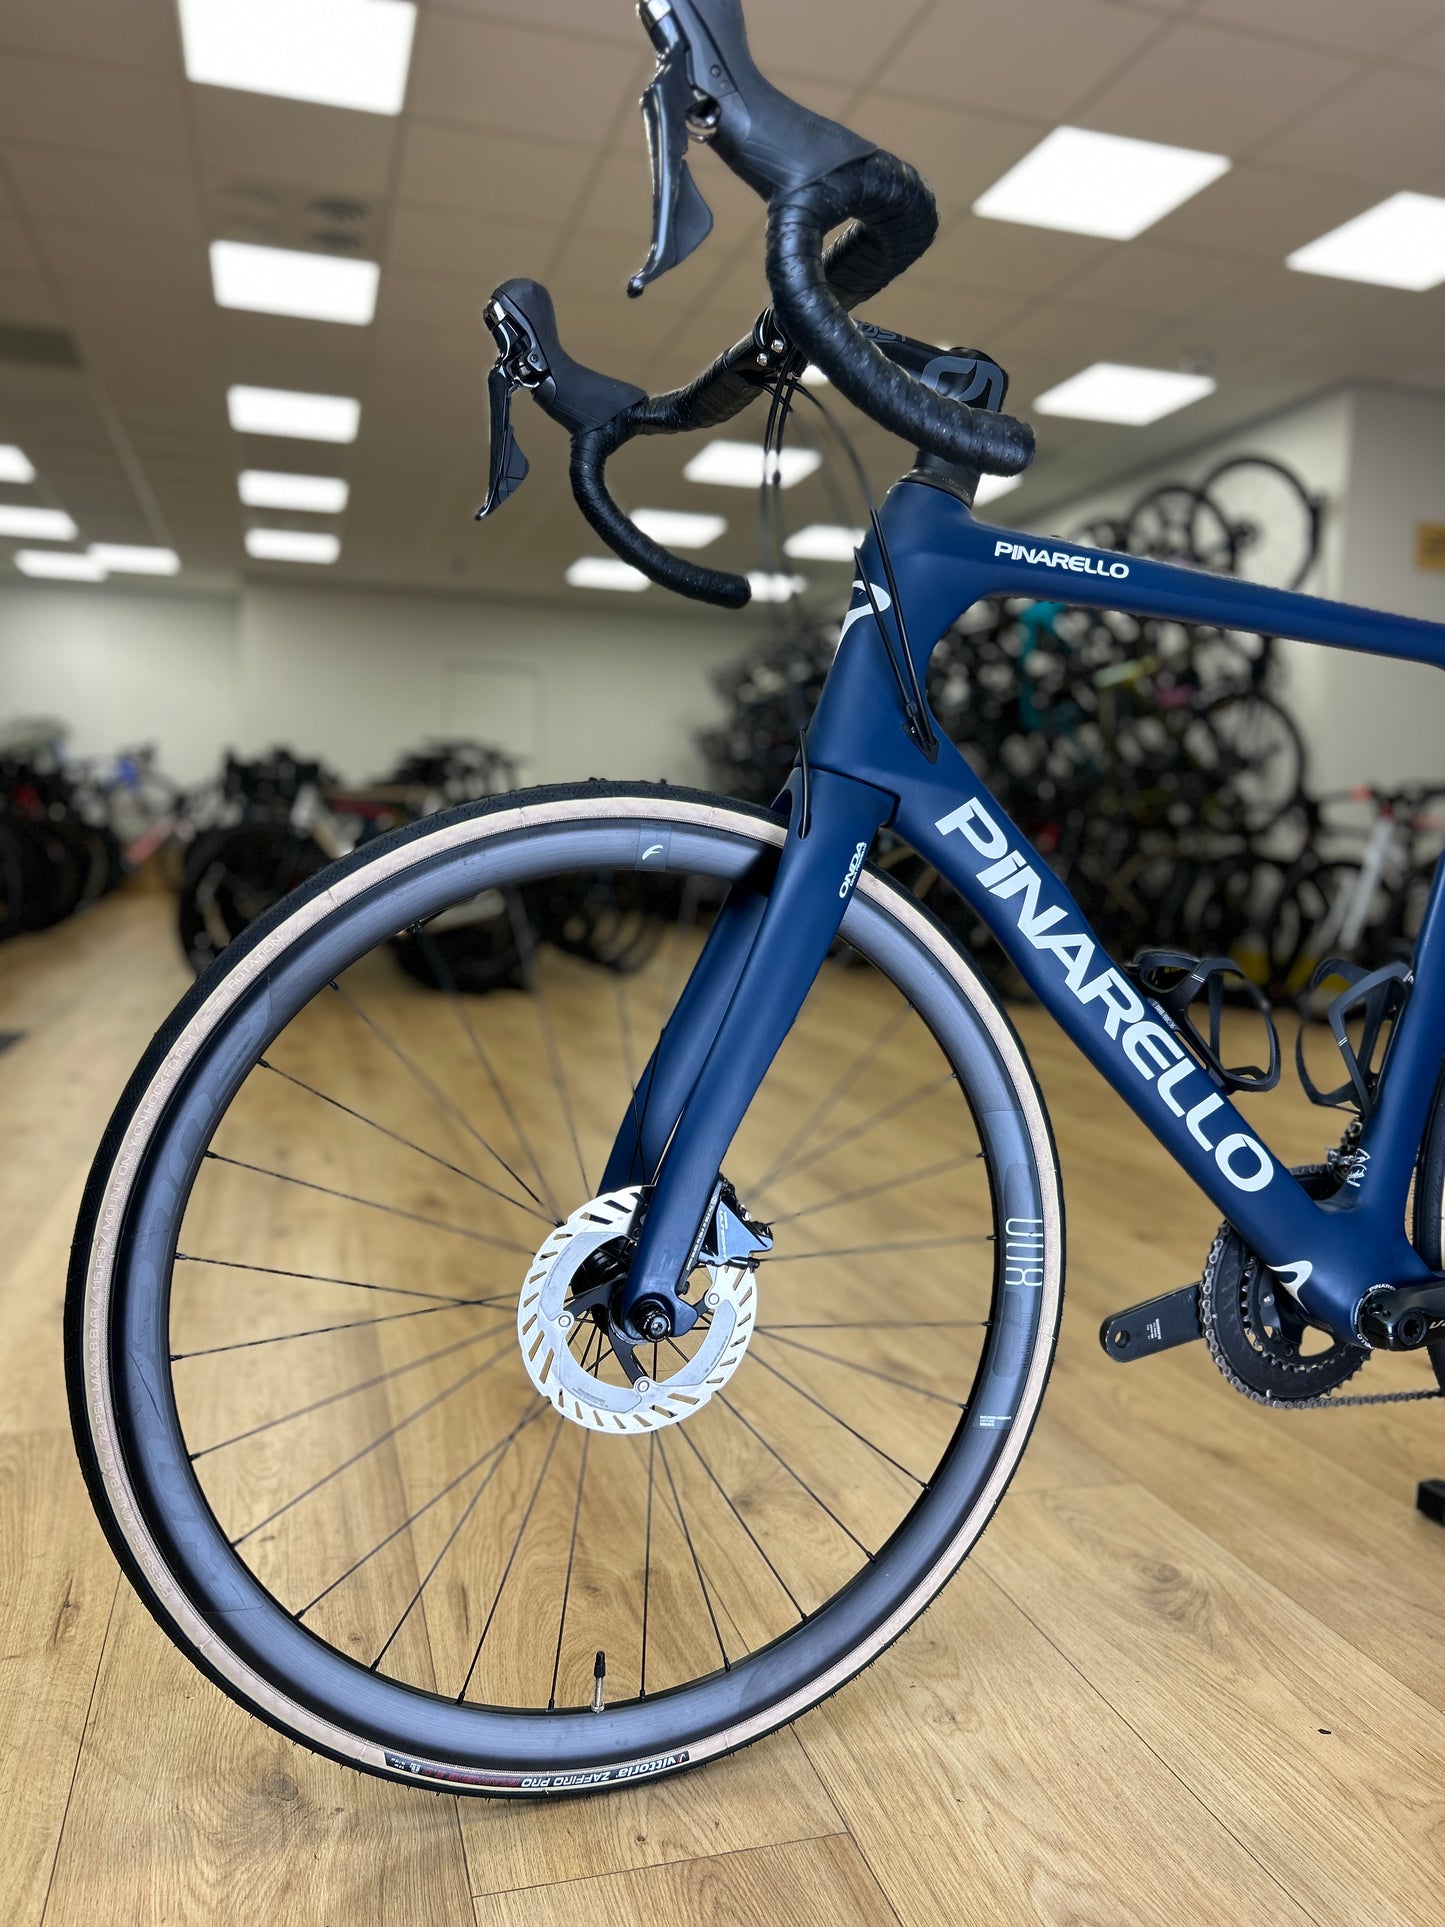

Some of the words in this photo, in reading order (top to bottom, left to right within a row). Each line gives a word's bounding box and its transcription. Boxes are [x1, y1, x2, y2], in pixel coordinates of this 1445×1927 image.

[994, 541, 1130, 579] PINARELLO
[839, 842, 866, 899] ONDA
[226, 933, 283, 990] ROTATION
[934, 796, 1274, 1192] PINARELLO
[174, 1033, 195, 1058] RIM
[142, 1058, 179, 1114] HOOKED
[132, 1113, 148, 1136] ON
[117, 1136, 138, 1176] ONLY
[101, 1179, 123, 1231] MOUNT
[95, 1244, 107, 1268] PSI
[92, 1270, 103, 1290] 115
[89, 1307, 99, 1338] BAR
[93, 1401, 104, 1423] PSI
[96, 1427, 108, 1446] 72
[104, 1458, 119, 1488] BAR
[131, 1532, 171, 1598] PRESSURE
[521, 1777, 550, 1787] PRO
[553, 1771, 610, 1786] ZAFFIRO
